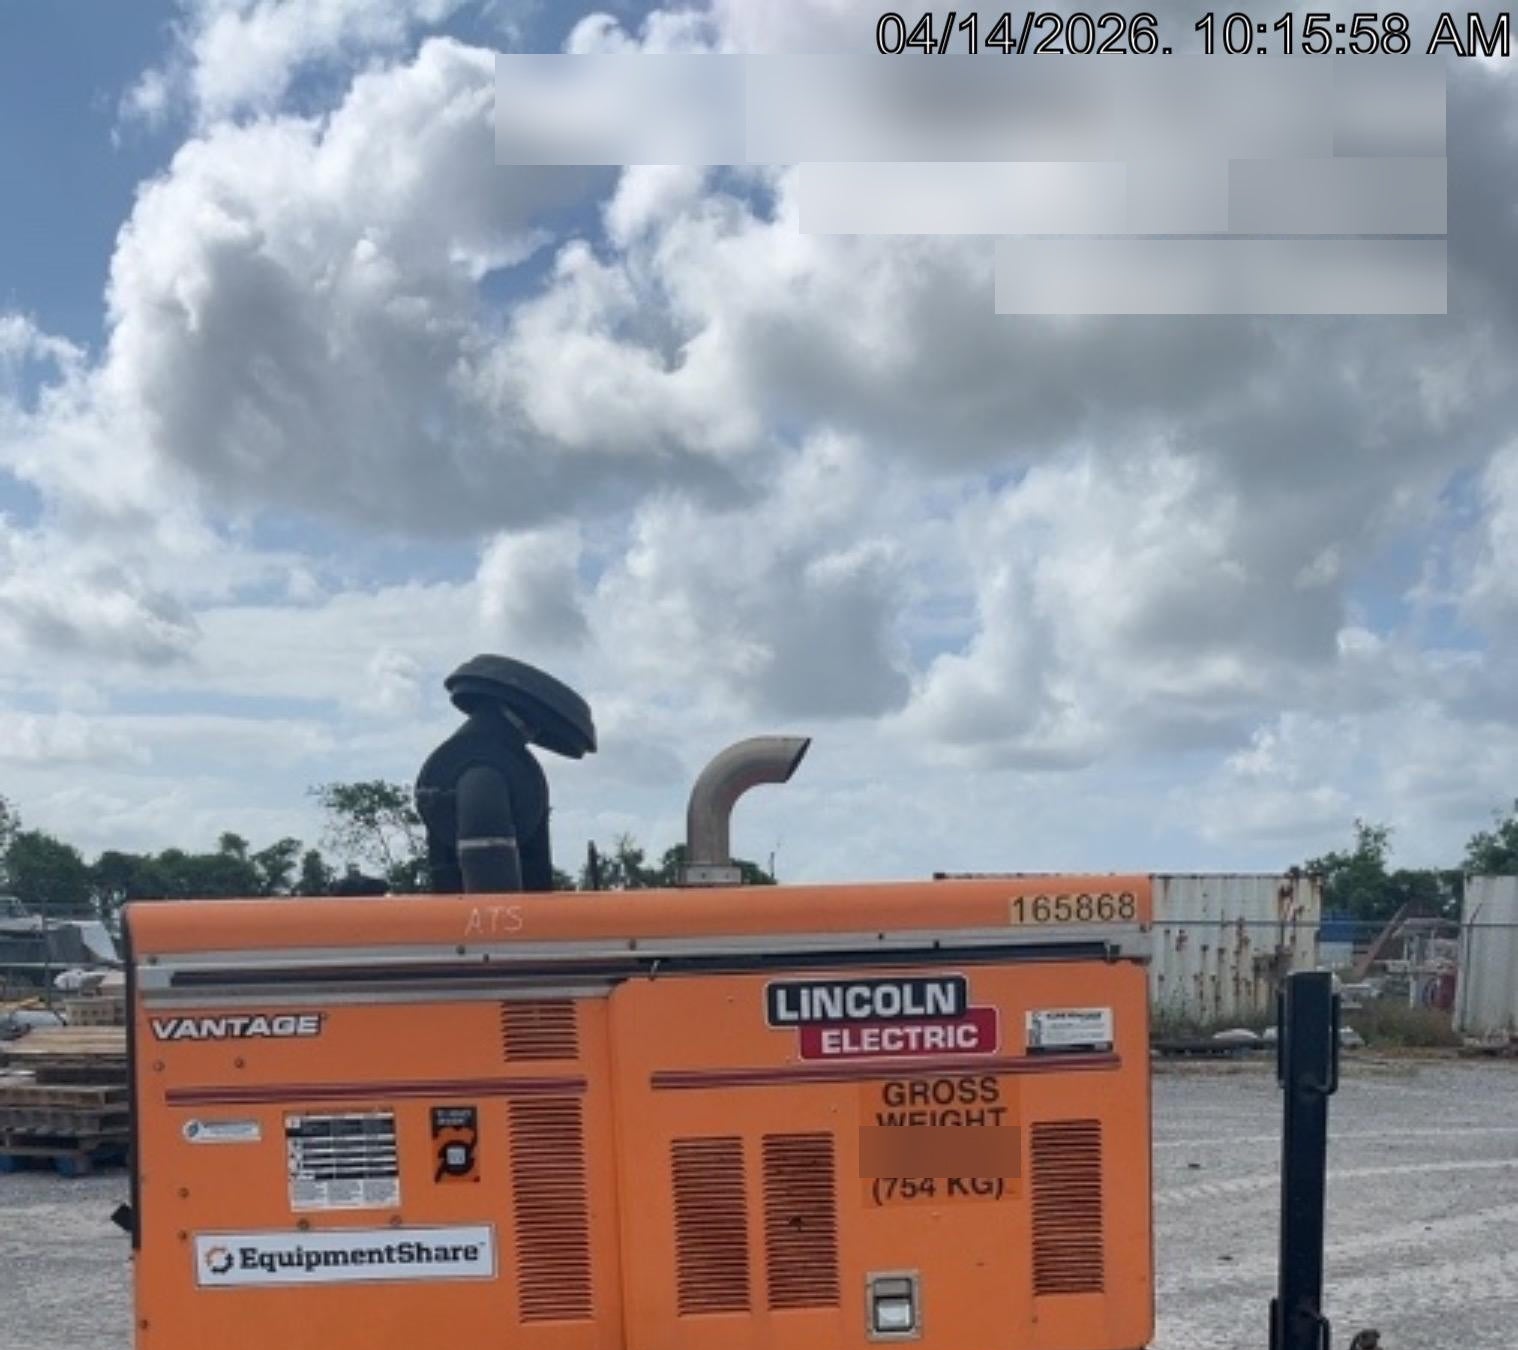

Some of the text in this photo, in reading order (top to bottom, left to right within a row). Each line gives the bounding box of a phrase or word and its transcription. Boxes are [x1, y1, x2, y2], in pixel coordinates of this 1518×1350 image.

[464, 905, 523, 936] ATS
[1013, 892, 1135, 922] 165868
[776, 983, 956, 1021] LINCOLN
[152, 1013, 322, 1040] VANTAGE
[821, 1024, 979, 1054] ELECTRIC
[882, 1076, 1000, 1106] GROSS
